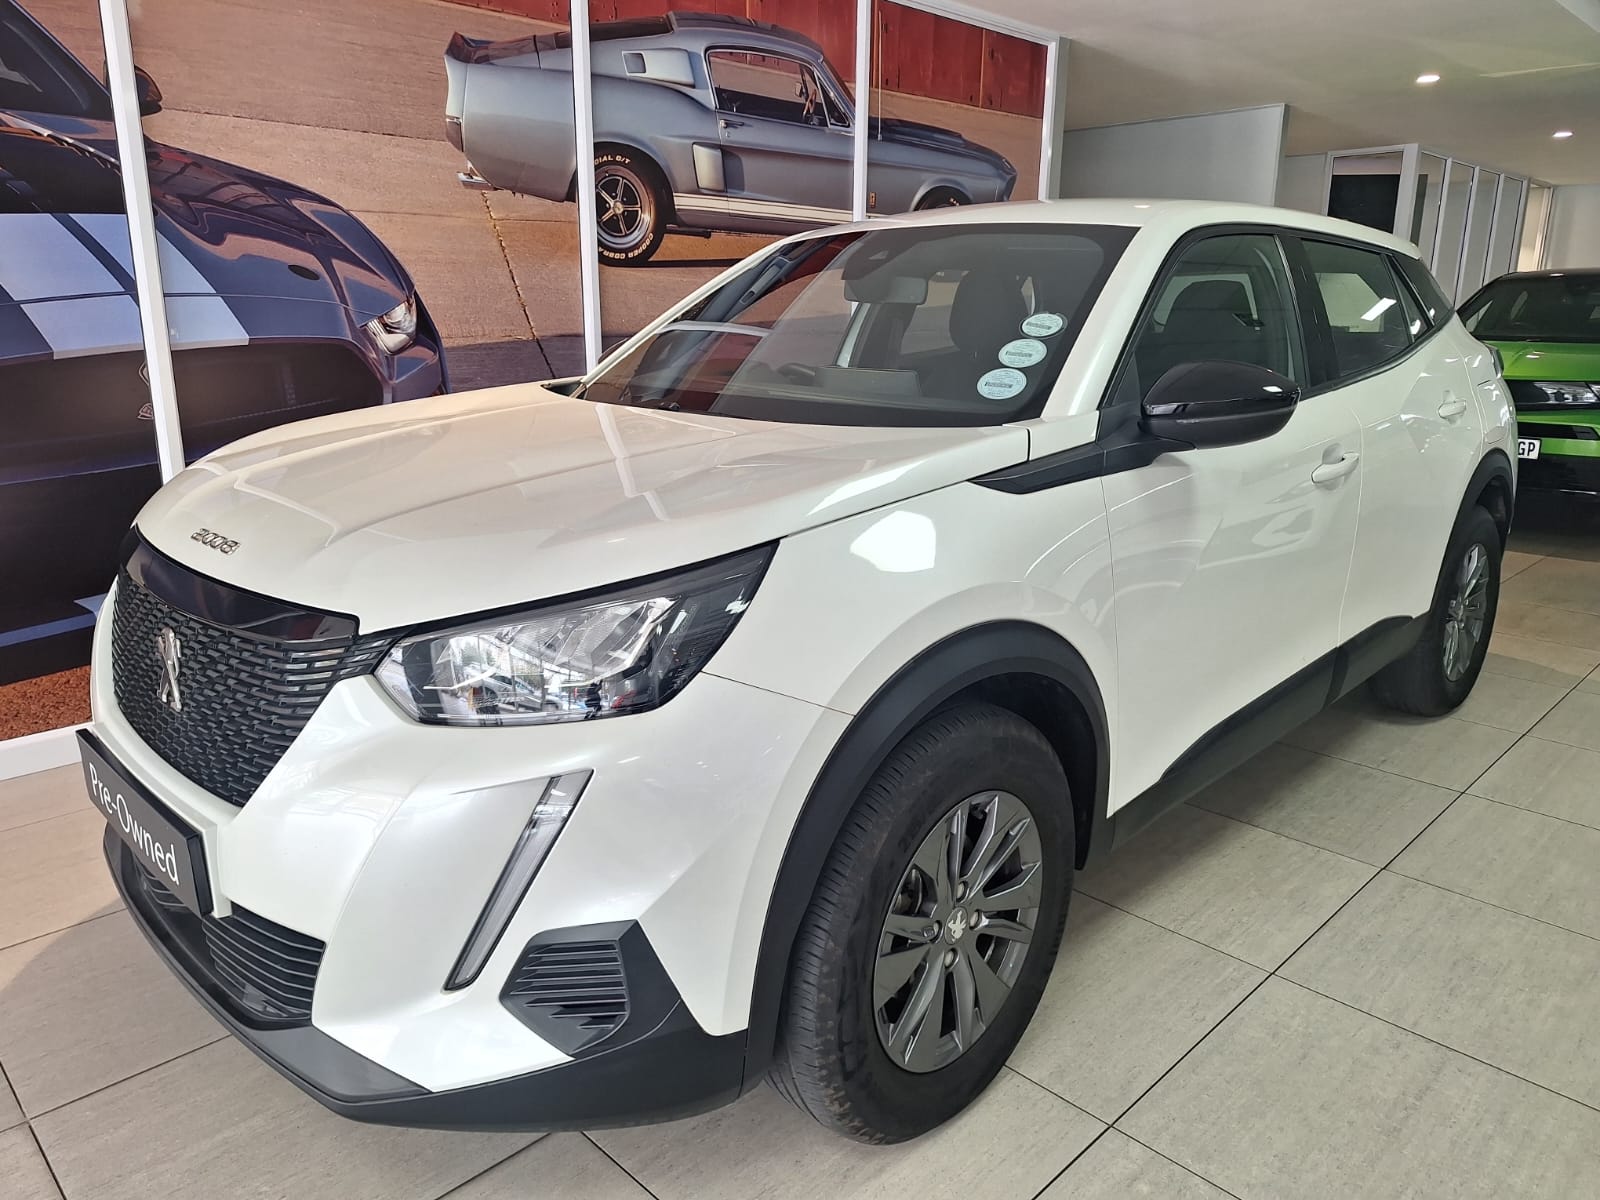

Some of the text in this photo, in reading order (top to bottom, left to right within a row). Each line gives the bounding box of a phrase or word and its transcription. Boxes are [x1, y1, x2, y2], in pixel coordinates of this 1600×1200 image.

[598, 232, 654, 259] COOPER COBRA
[1518, 441, 1535, 456] GP
[191, 528, 240, 555] 2008
[88, 762, 180, 885] Pre-Owned
